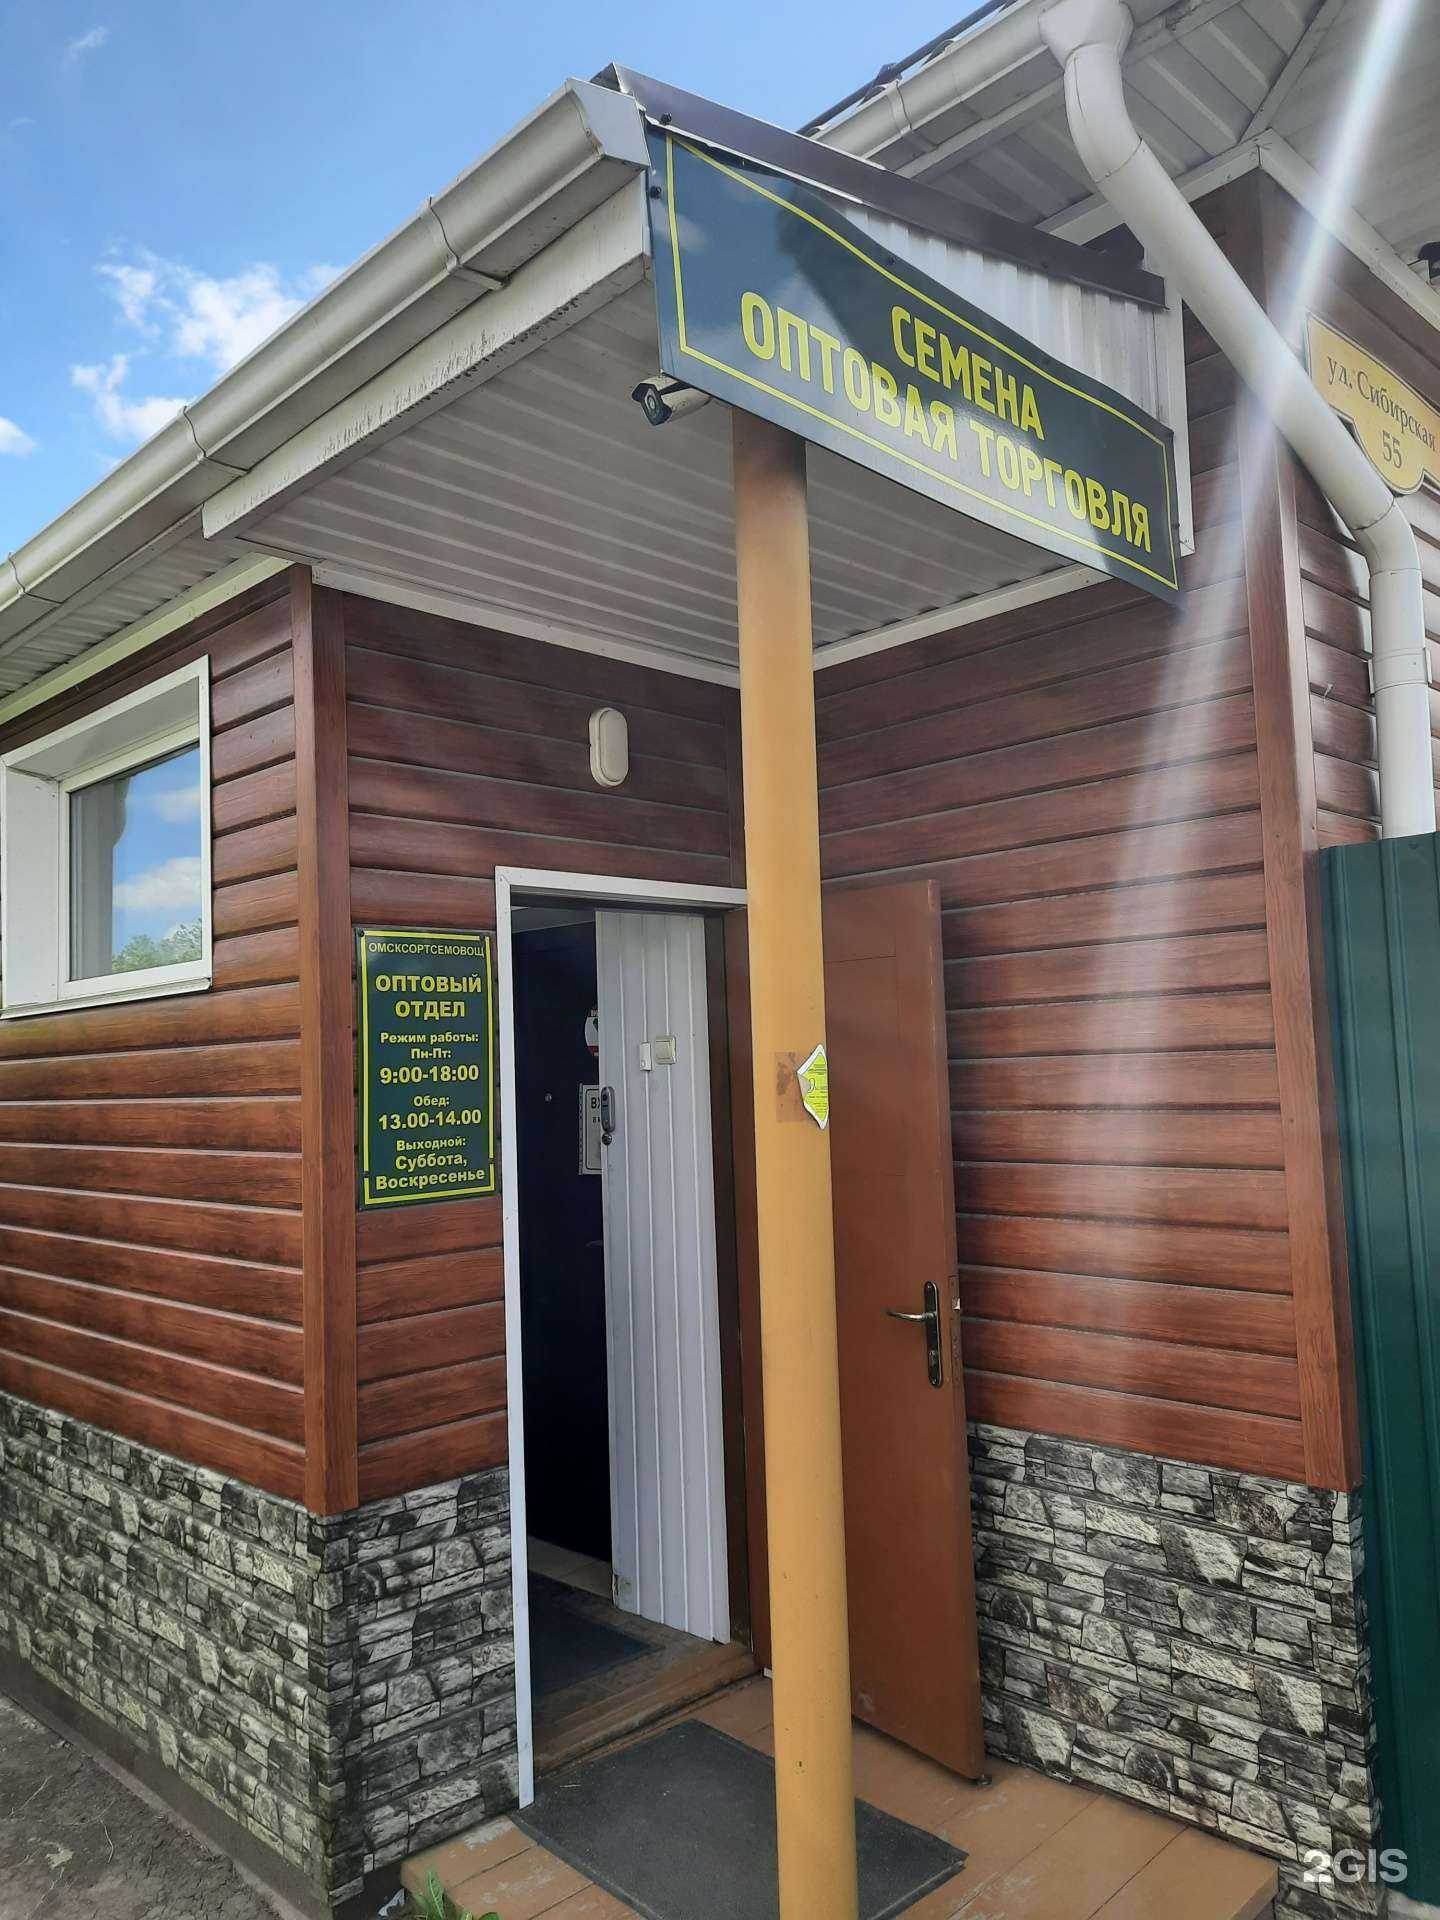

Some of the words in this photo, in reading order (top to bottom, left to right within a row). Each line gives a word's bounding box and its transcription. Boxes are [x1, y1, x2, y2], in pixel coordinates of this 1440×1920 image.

[891, 306, 1045, 440] СЕМЕНА
[1327, 356, 1352, 389] ул.
[1357, 371, 1436, 452] Сибирская
[740, 291, 958, 461] ОПТОВАЯ
[968, 420, 1152, 553] ТОРГОВЛЯ
[1382, 430, 1402, 469] 55
[368, 942, 485, 957] ОМСКСОРТСЕМОВОЩ
[375, 973, 482, 993] ОПТОВЫЙ
[395, 1000, 465, 1020] ОТДЕЛ
[380, 1032, 426, 1043] Режим
[430, 1032, 479, 1045] работы:
[411, 1048, 452, 1059] Пн-Пт:
[380, 1065, 479, 1084] 9:00-18:00
[413, 1095, 450, 1107] Обед:
[378, 1109, 482, 1130] 13.00-14.00
[396, 1136, 466, 1151] Выходной:
[395, 1153, 467, 1172] Суббота,
[375, 1169, 485, 1190] Воскресенье
